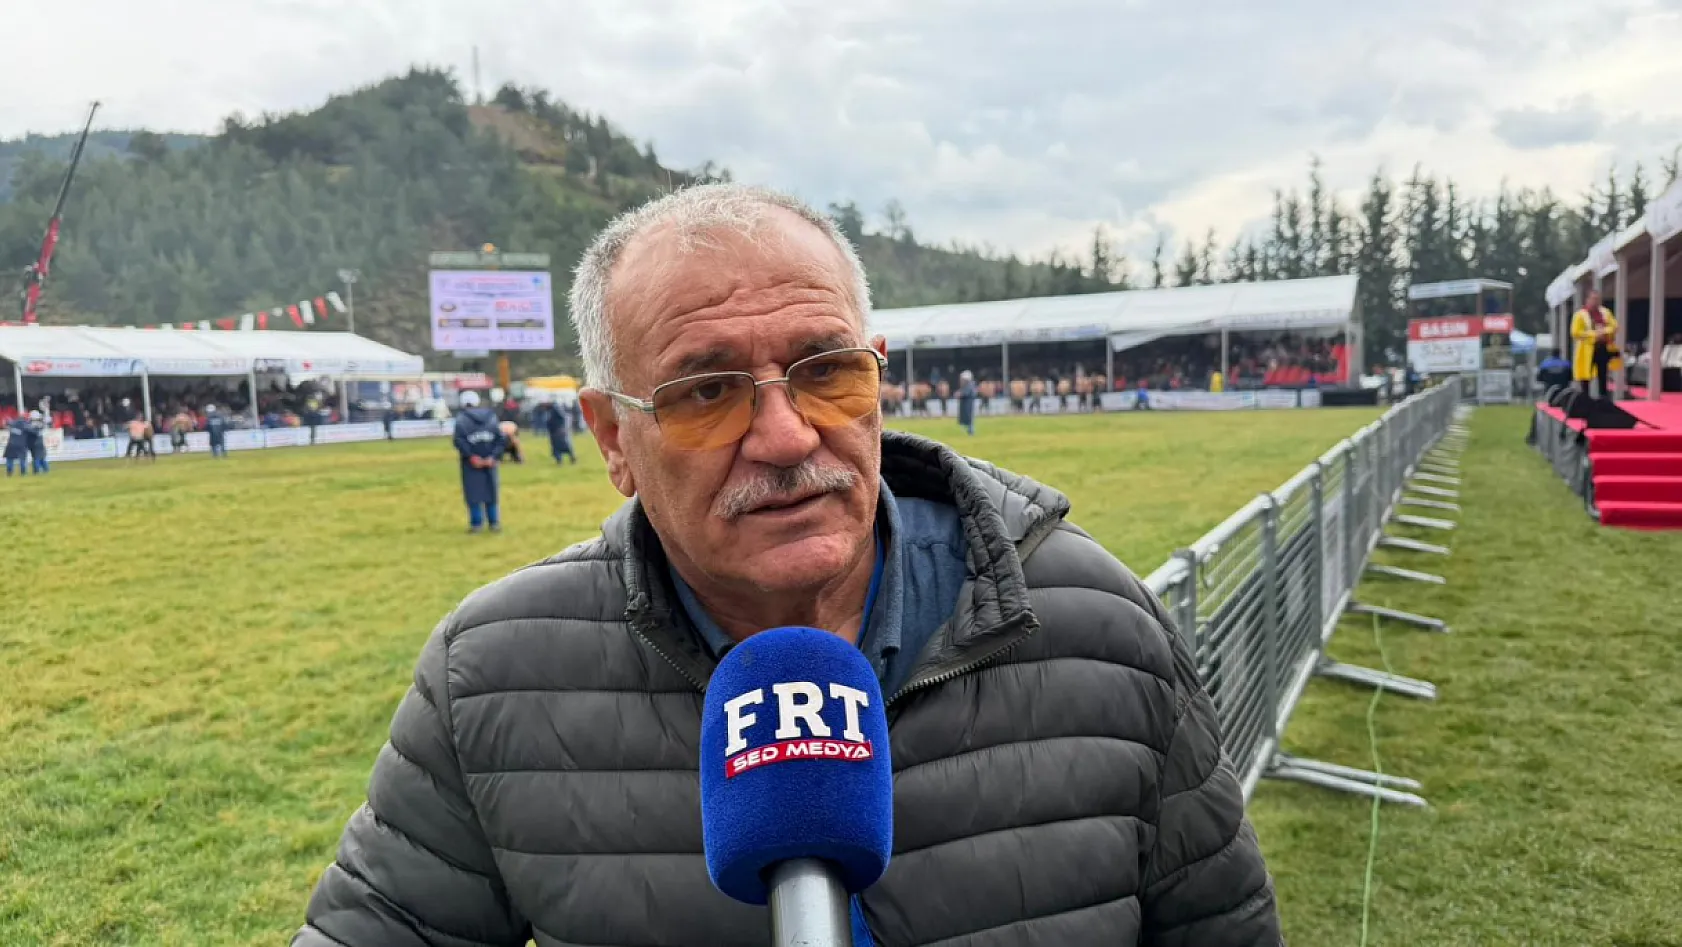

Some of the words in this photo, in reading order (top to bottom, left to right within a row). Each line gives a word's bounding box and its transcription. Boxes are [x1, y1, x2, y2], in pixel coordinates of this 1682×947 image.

[723, 681, 869, 757] FRT
[732, 747, 779, 773] SED
[785, 742, 871, 759] MEDYA
